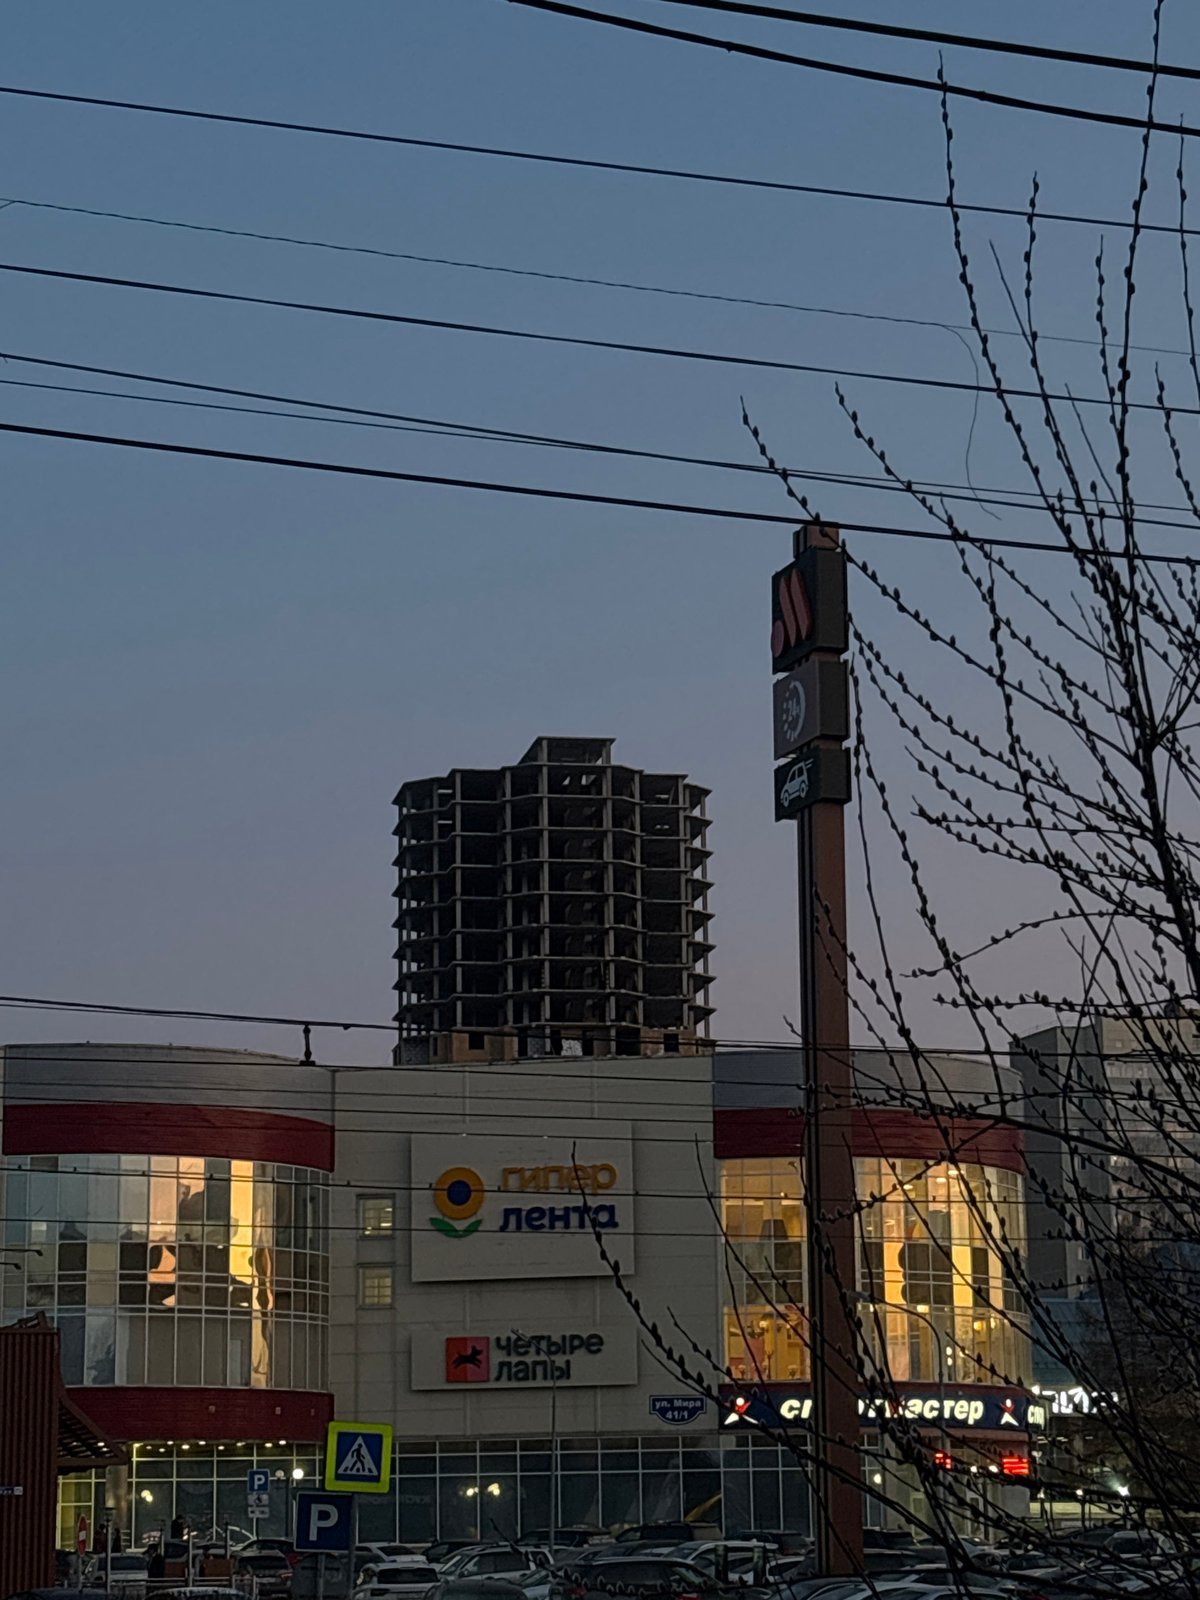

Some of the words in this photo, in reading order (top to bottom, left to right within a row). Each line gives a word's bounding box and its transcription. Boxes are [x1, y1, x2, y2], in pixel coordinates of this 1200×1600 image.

[502, 1164, 617, 1196] гипер
[500, 1204, 619, 1231] лента
[495, 1333, 604, 1356] четыре
[494, 1359, 571, 1382] лапы
[655, 1400, 671, 1410] ул.
[673, 1399, 702, 1409] Мира
[665, 1410, 689, 1420] 41/1
[254, 1474, 265, 1490] P
[309, 1503, 339, 1542] P
